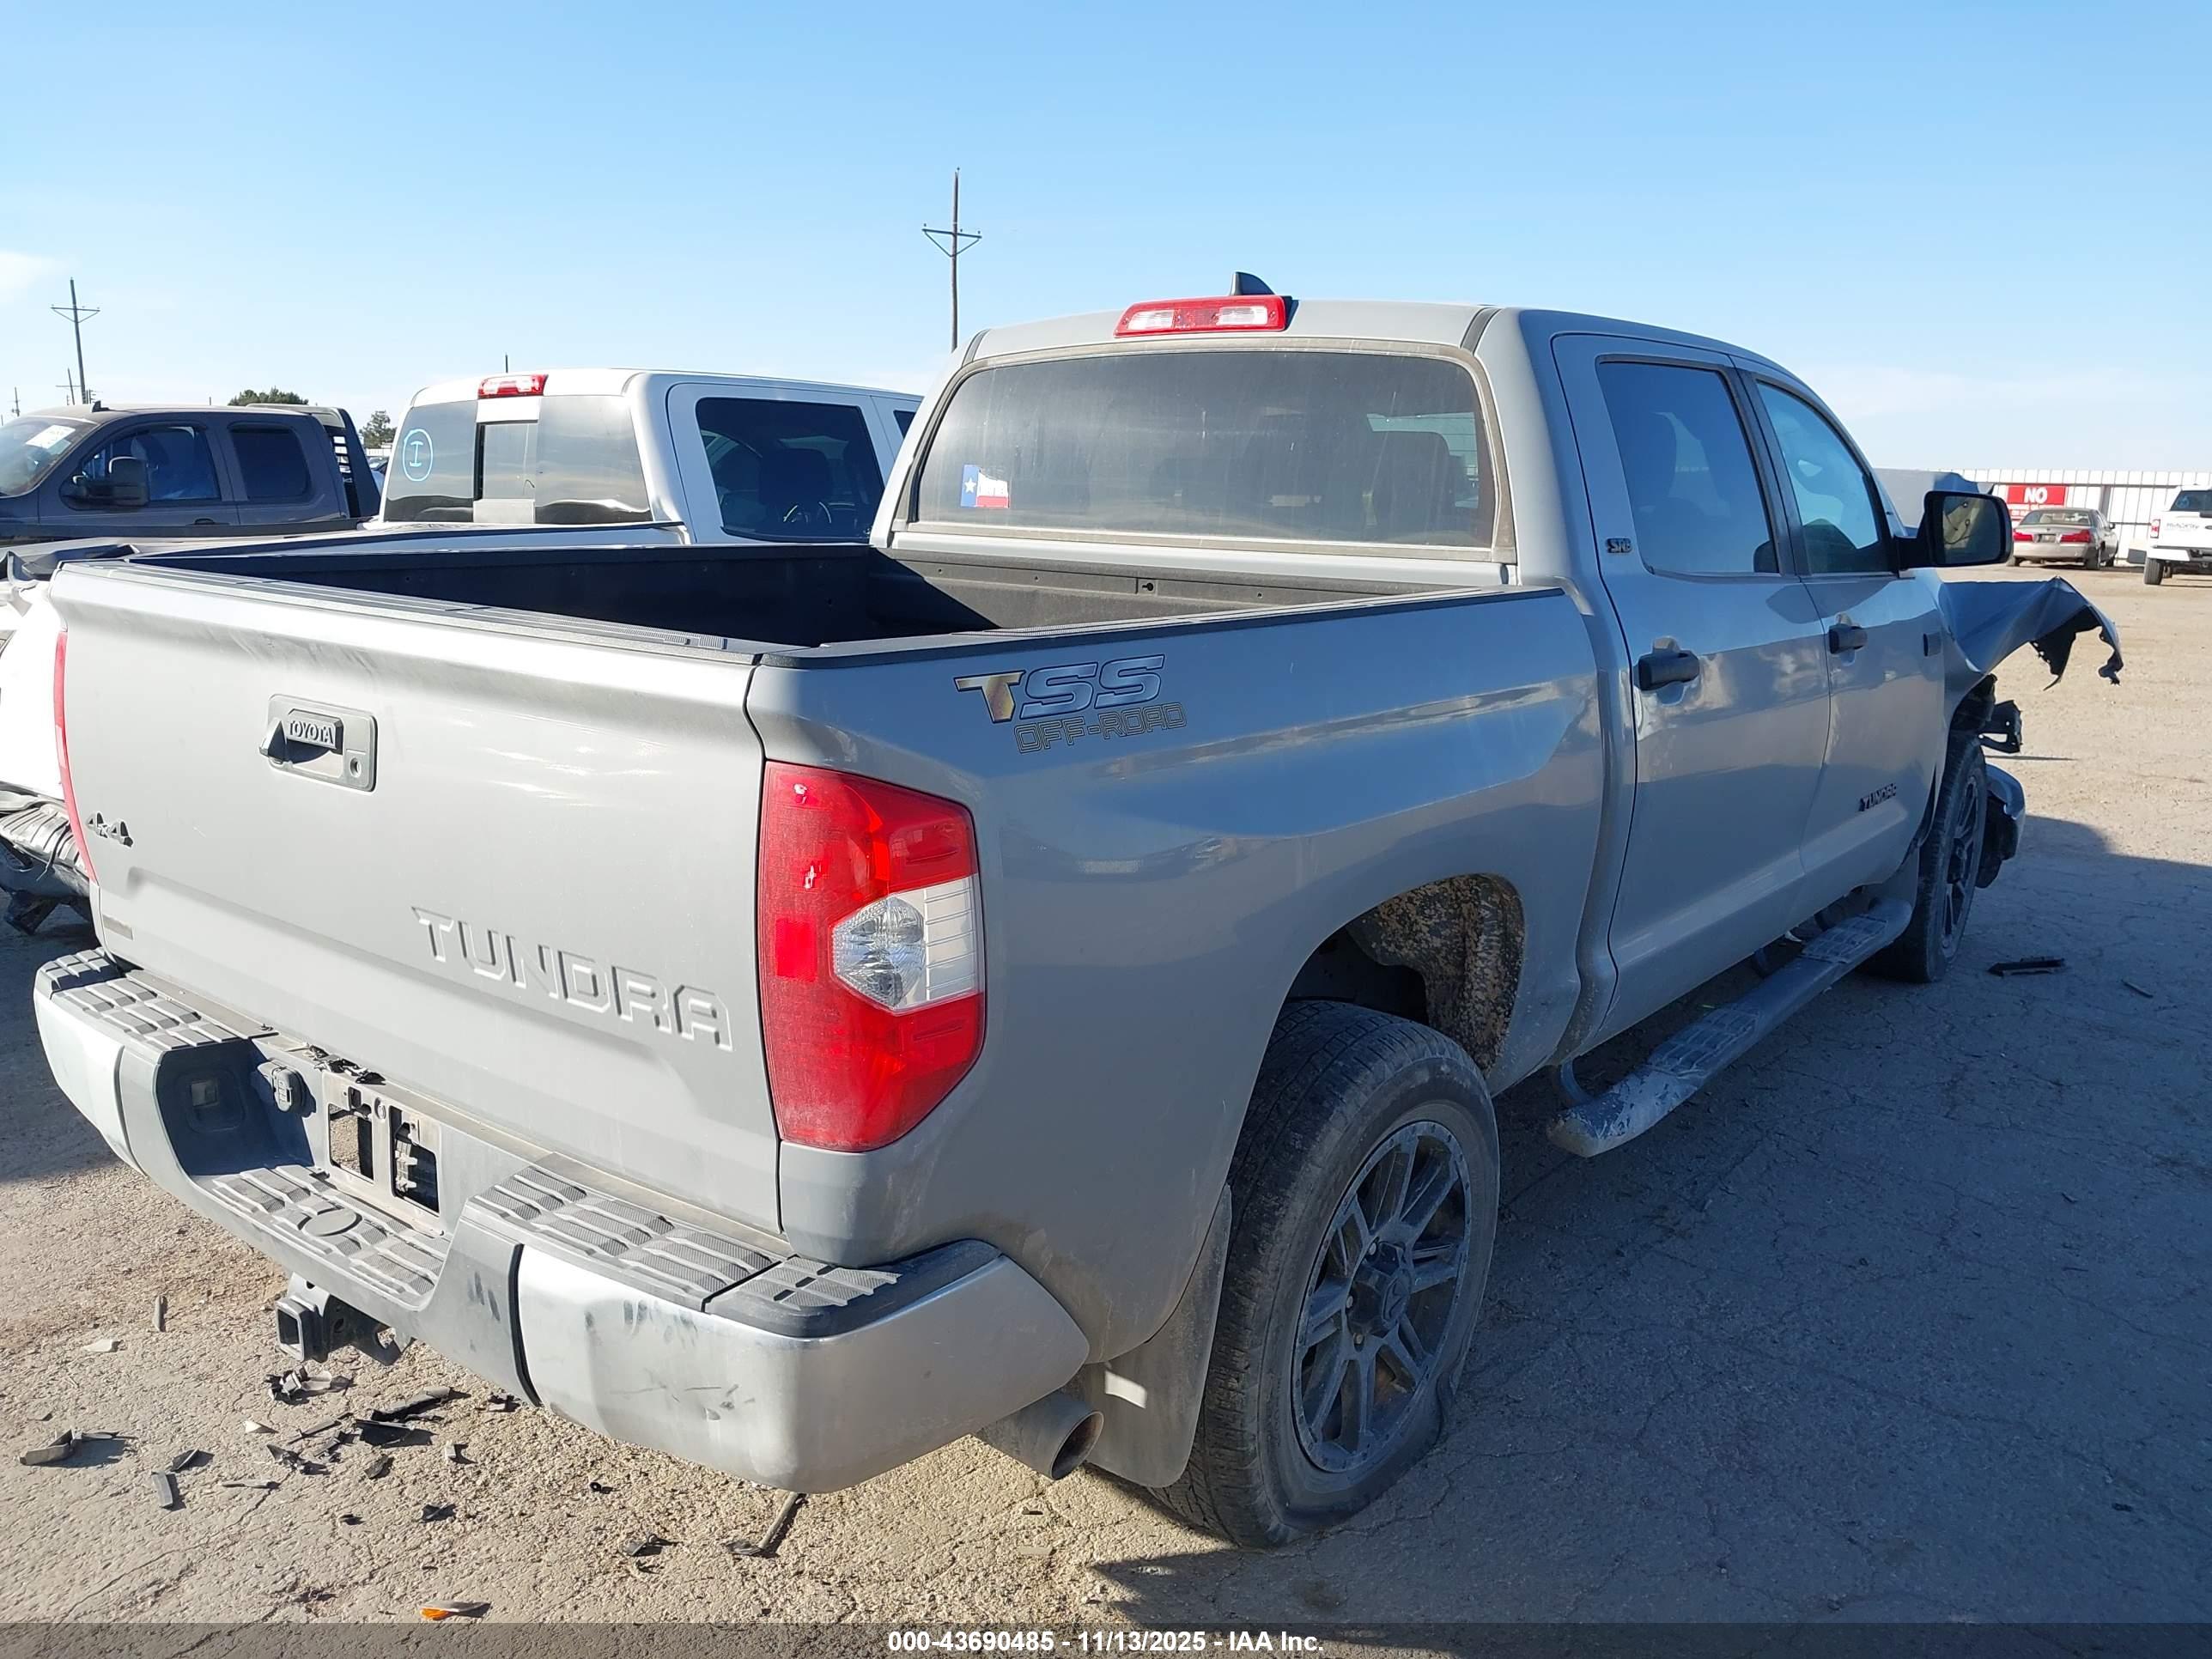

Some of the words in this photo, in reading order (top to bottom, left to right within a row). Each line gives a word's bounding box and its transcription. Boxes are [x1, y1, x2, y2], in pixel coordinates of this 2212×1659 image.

[2023, 487, 2048, 504] NO
[953, 653, 1165, 723] TSS
[289, 720, 334, 744] TOYOTA
[1014, 702, 1187, 753] OFF-ROAD
[411, 907, 734, 1051] TUNDRA
